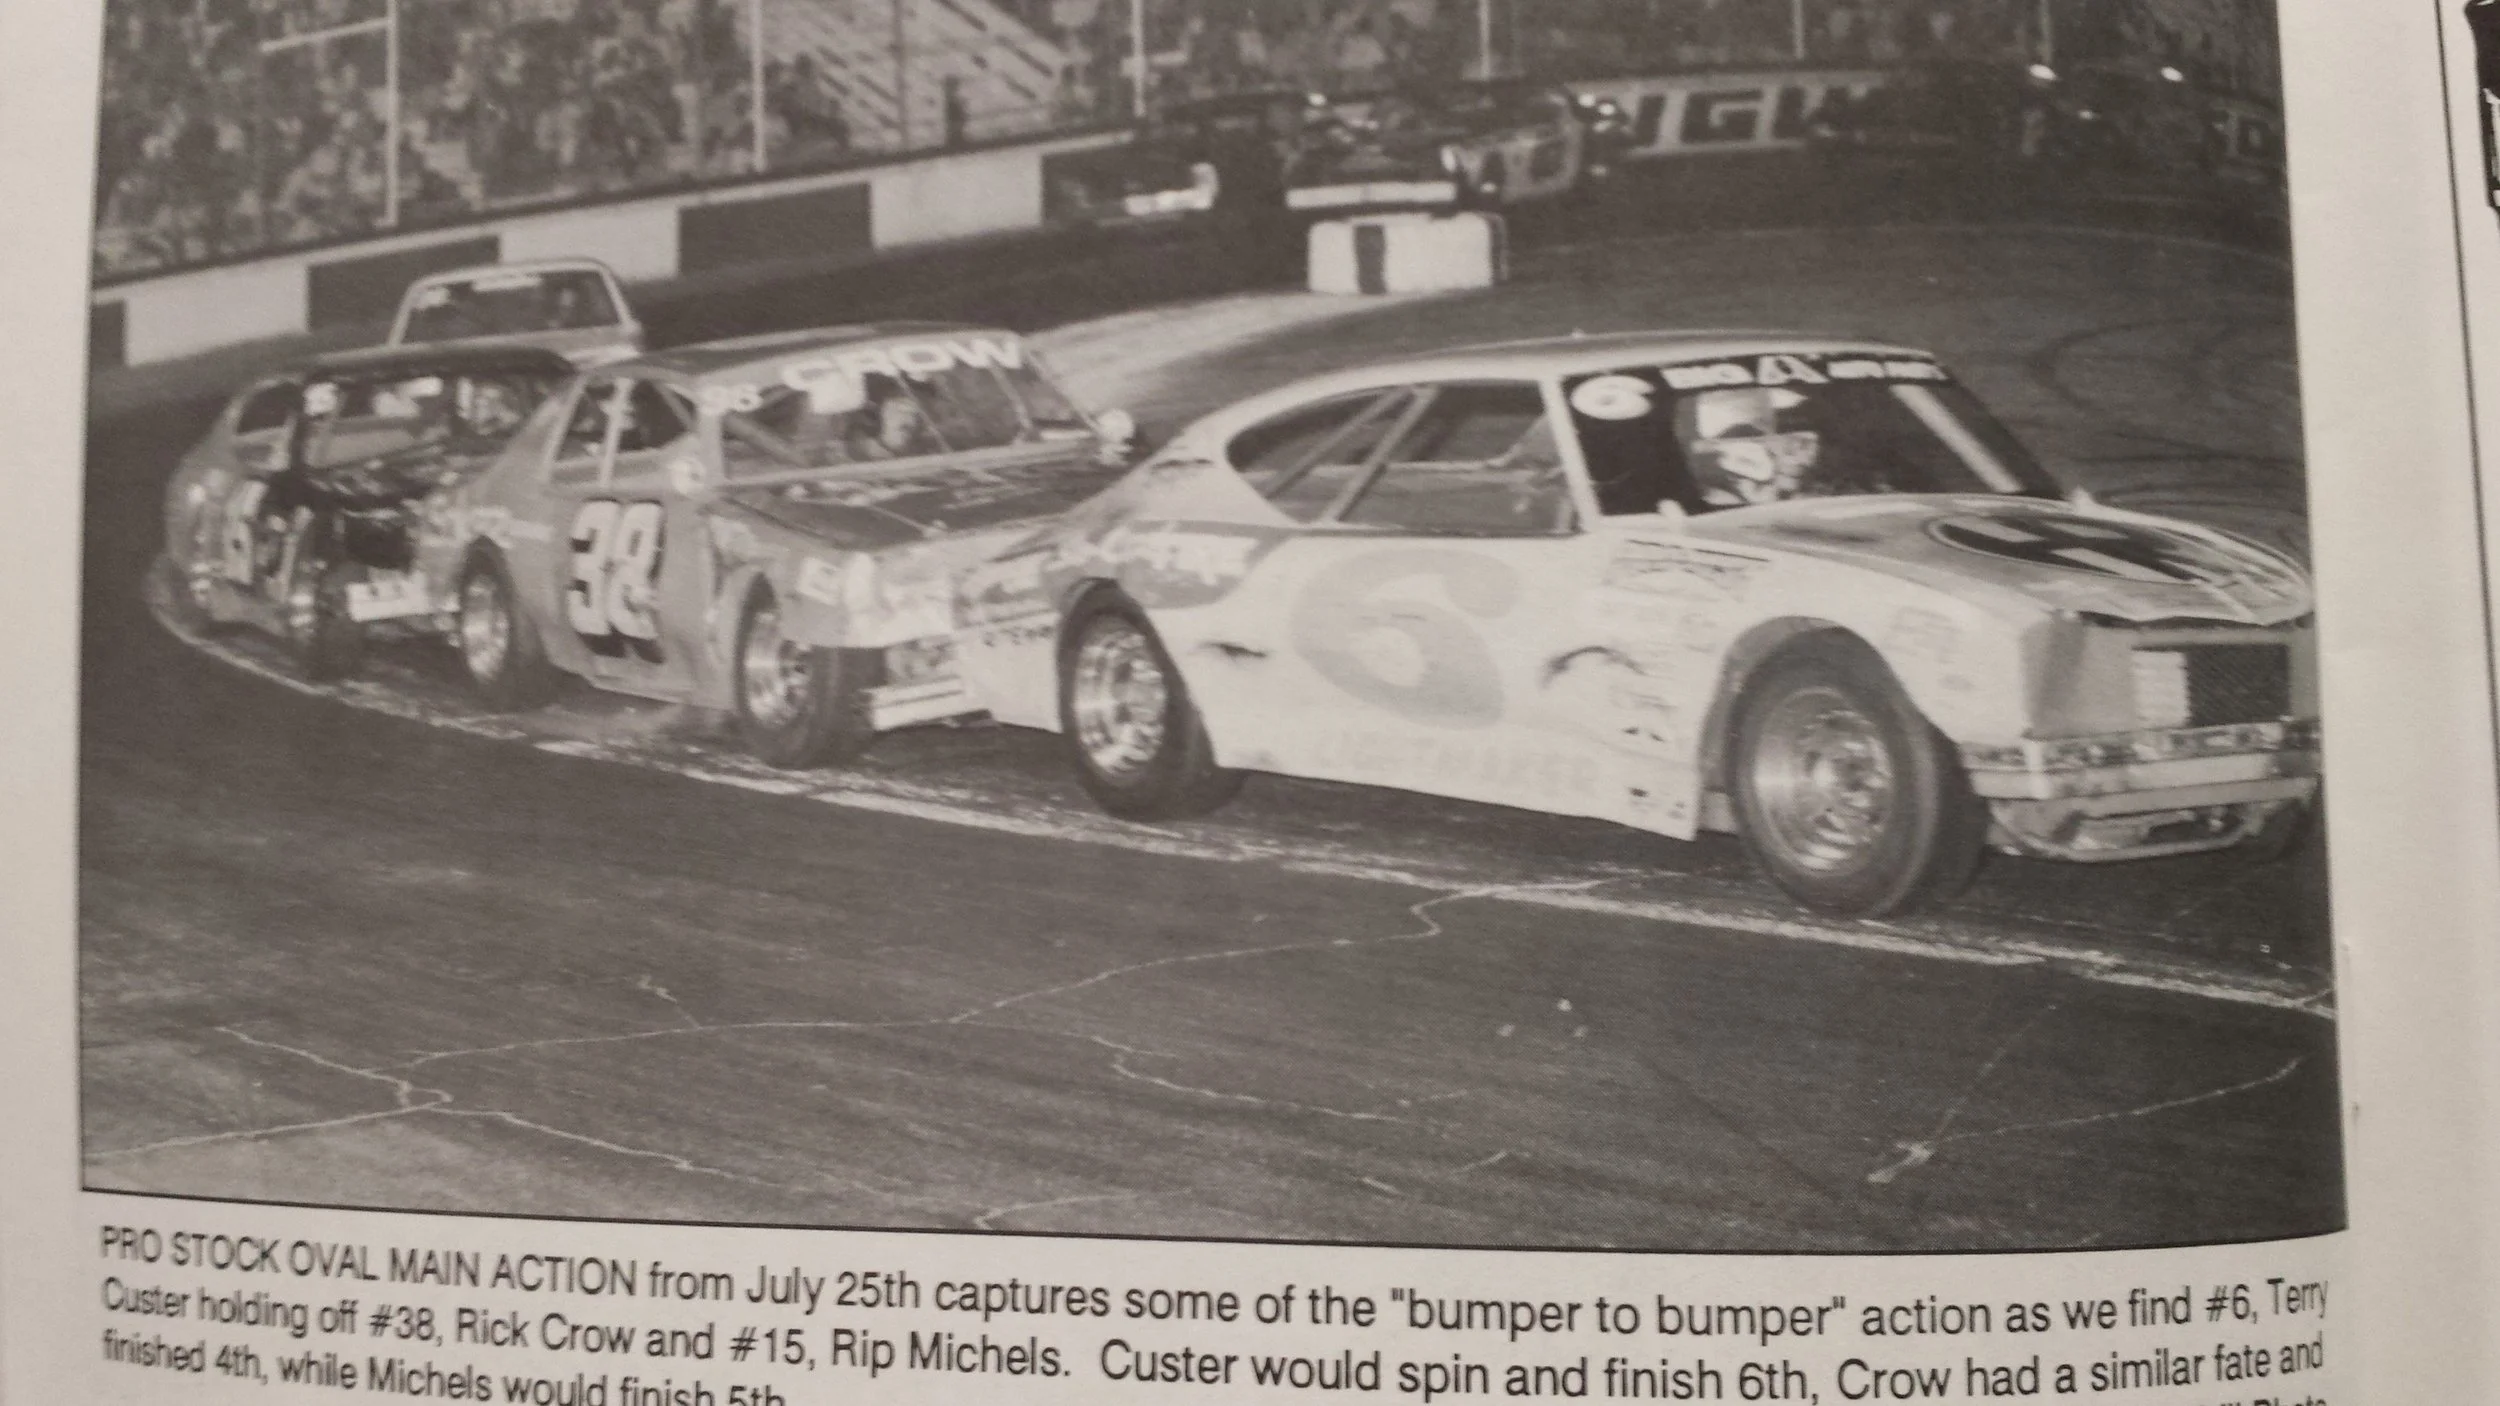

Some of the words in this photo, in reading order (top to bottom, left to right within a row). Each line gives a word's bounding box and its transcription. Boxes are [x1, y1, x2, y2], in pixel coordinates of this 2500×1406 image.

[780, 337, 1022, 394] CROW
[1572, 375, 1657, 420] 6
[566, 498, 667, 645] 38
[1290, 548, 1520, 728] 6
[101, 1225, 162, 1263] PRO
[171, 1230, 282, 1273] STOCK
[289, 1240, 380, 1280] OVAL
[388, 1247, 480, 1287] MAIN
[490, 1253, 637, 1296] ACTION
[650, 1260, 733, 1300] from
[747, 1265, 825, 1315] July
[836, 1270, 920, 1308] 25th
[935, 1278, 1110, 1322] captures
[1125, 1288, 1240, 1321] some
[1256, 1284, 1296, 1323] of
[1308, 1285, 1376, 1327] the
[1391, 1287, 1582, 1342] "bumper
[1596, 1297, 1640, 1333] to
[1657, 1295, 1846, 1346] bumper"
[1862, 1295, 1991, 1335] action
[2006, 1302, 2051, 1332] as
[2063, 1299, 2117, 1329] we
[2128, 1285, 2191, 1327] find
[2205, 1283, 2257, 1324] #6,
[2265, 1277, 2328, 1319] Terry
[102, 1276, 190, 1317] Custer
[197, 1287, 309, 1338] holding
[319, 1300, 358, 1334] off
[369, 1304, 443, 1347] #38,
[456, 1308, 530, 1347] Rick
[541, 1313, 636, 1353] Crow
[647, 1322, 715, 1359] and
[729, 1326, 816, 1370] #15,
[831, 1328, 896, 1377] Rip
[909, 1331, 1071, 1377] Michels.
[1101, 1339, 1239, 1383] Custer
[1250, 1350, 1381, 1391] would
[1399, 1353, 1490, 1403] spin
[1506, 1356, 1588, 1396] and
[1604, 1357, 1722, 1399] finish
[1739, 1360, 1818, 1405] 6th,
[1838, 1358, 1951, 1400] Crow
[1967, 1355, 2040, 1396] had
[2056, 1364, 2077, 1393] a
[2091, 1348, 2204, 1393] similar
[2215, 1343, 2271, 1381] fate
[2279, 1331, 2323, 1374] and
[103, 1328, 205, 1373] finished
[214, 1344, 268, 1385] 4th,
[277, 1351, 358, 1390] while
[367, 1356, 492, 1401] Michels
[502, 1372, 608, 1406] would
[620, 1375, 715, 1406] finish
